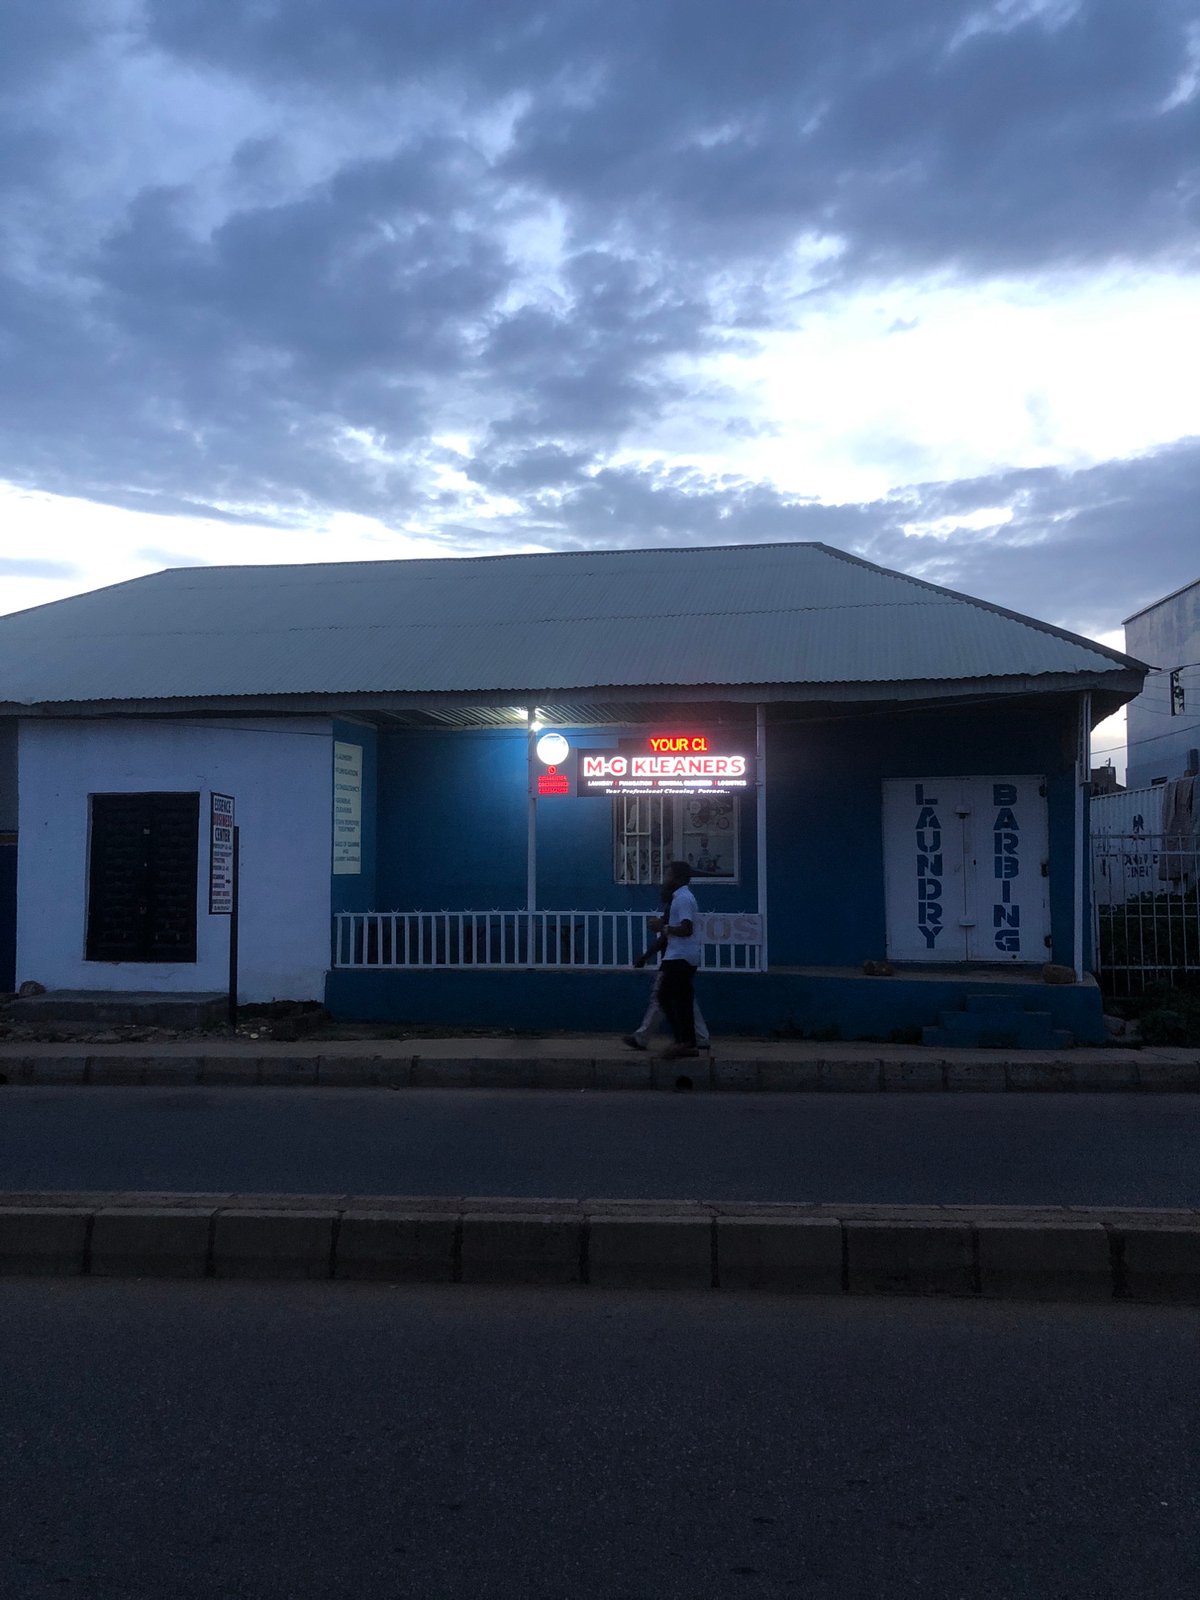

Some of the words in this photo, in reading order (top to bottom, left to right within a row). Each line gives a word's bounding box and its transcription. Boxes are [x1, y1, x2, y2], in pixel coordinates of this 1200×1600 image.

[650, 738, 688, 751] YOUR
[692, 738, 707, 751] CL
[585, 757, 625, 775] M-G
[633, 757, 744, 775] KLEANERS
[214, 797, 231, 814] ESSENCE
[215, 827, 230, 843] CENTER
[915, 784, 944, 949] LAUNDRY
[993, 784, 1020, 952] BARBING
